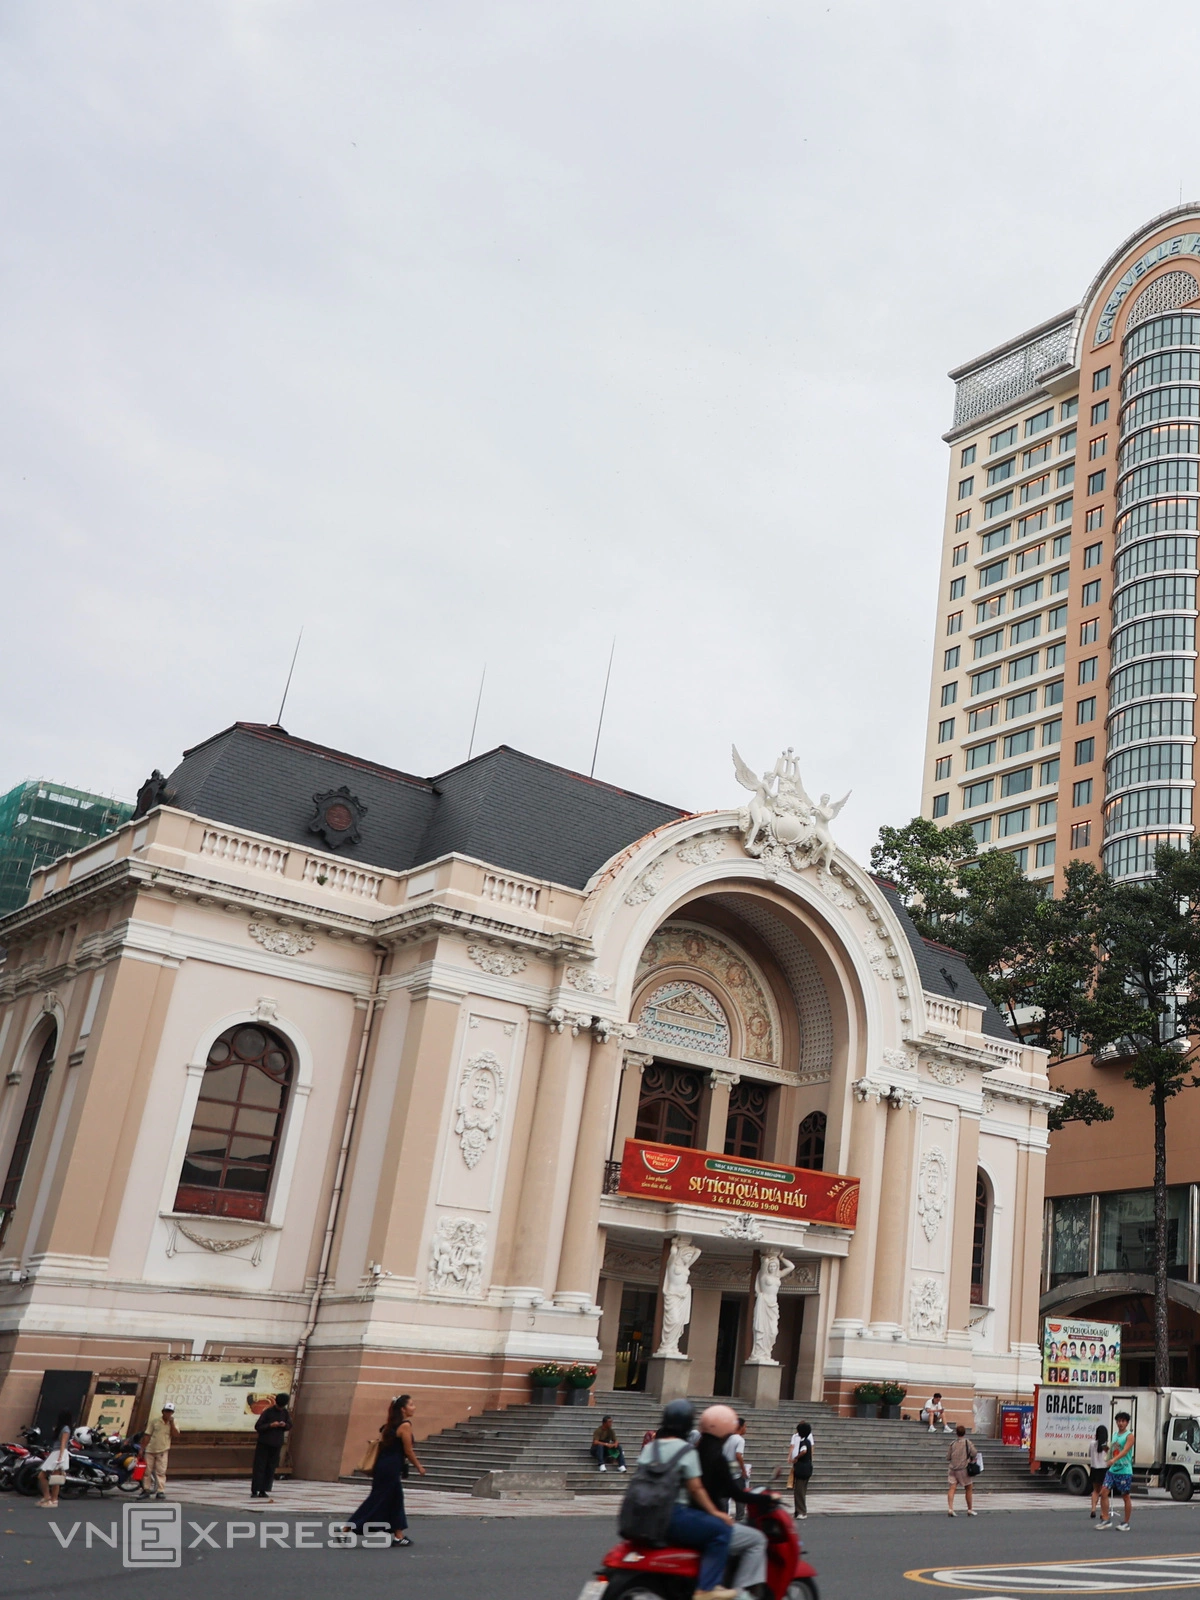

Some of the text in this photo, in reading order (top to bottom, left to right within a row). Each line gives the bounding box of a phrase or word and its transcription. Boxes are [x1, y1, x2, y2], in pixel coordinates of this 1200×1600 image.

[1095, 238, 1183, 343] CARAVELLE
[688, 1176, 807, 1209] SỰ TÍCH QUẢ DƯA HẤU
[725, 1197, 759, 1209] 4.10.2026
[761, 1202, 779, 1211] 19:00
[167, 1374, 215, 1385] SAIGON
[165, 1383, 213, 1395] OPERA
[162, 1393, 212, 1406] HOUSE
[1046, 1394, 1103, 1415] GRACE team
